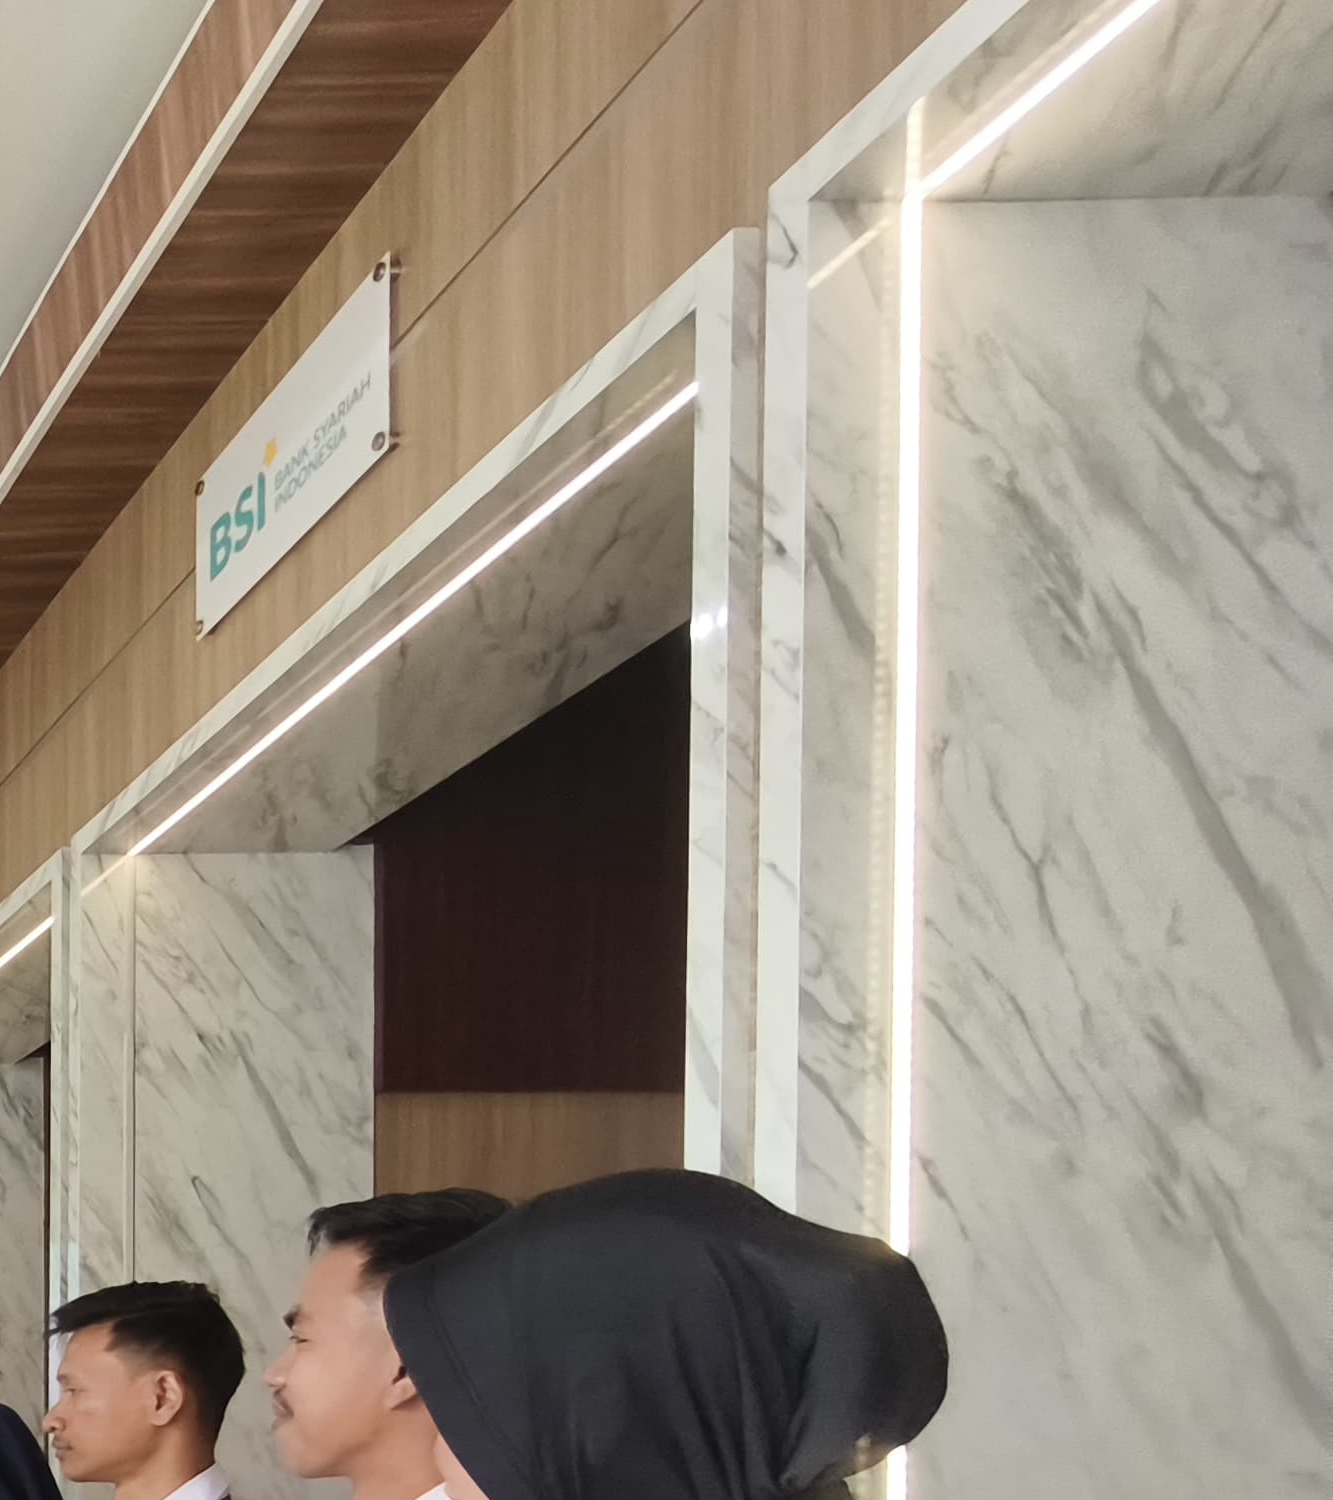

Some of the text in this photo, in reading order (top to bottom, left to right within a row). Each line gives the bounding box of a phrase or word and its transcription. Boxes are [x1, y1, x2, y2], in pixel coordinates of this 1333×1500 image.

[275, 370, 371, 492] BANK SYARIAH
[275, 425, 347, 513] INDONESIA
[210, 472, 266, 582] BSI
